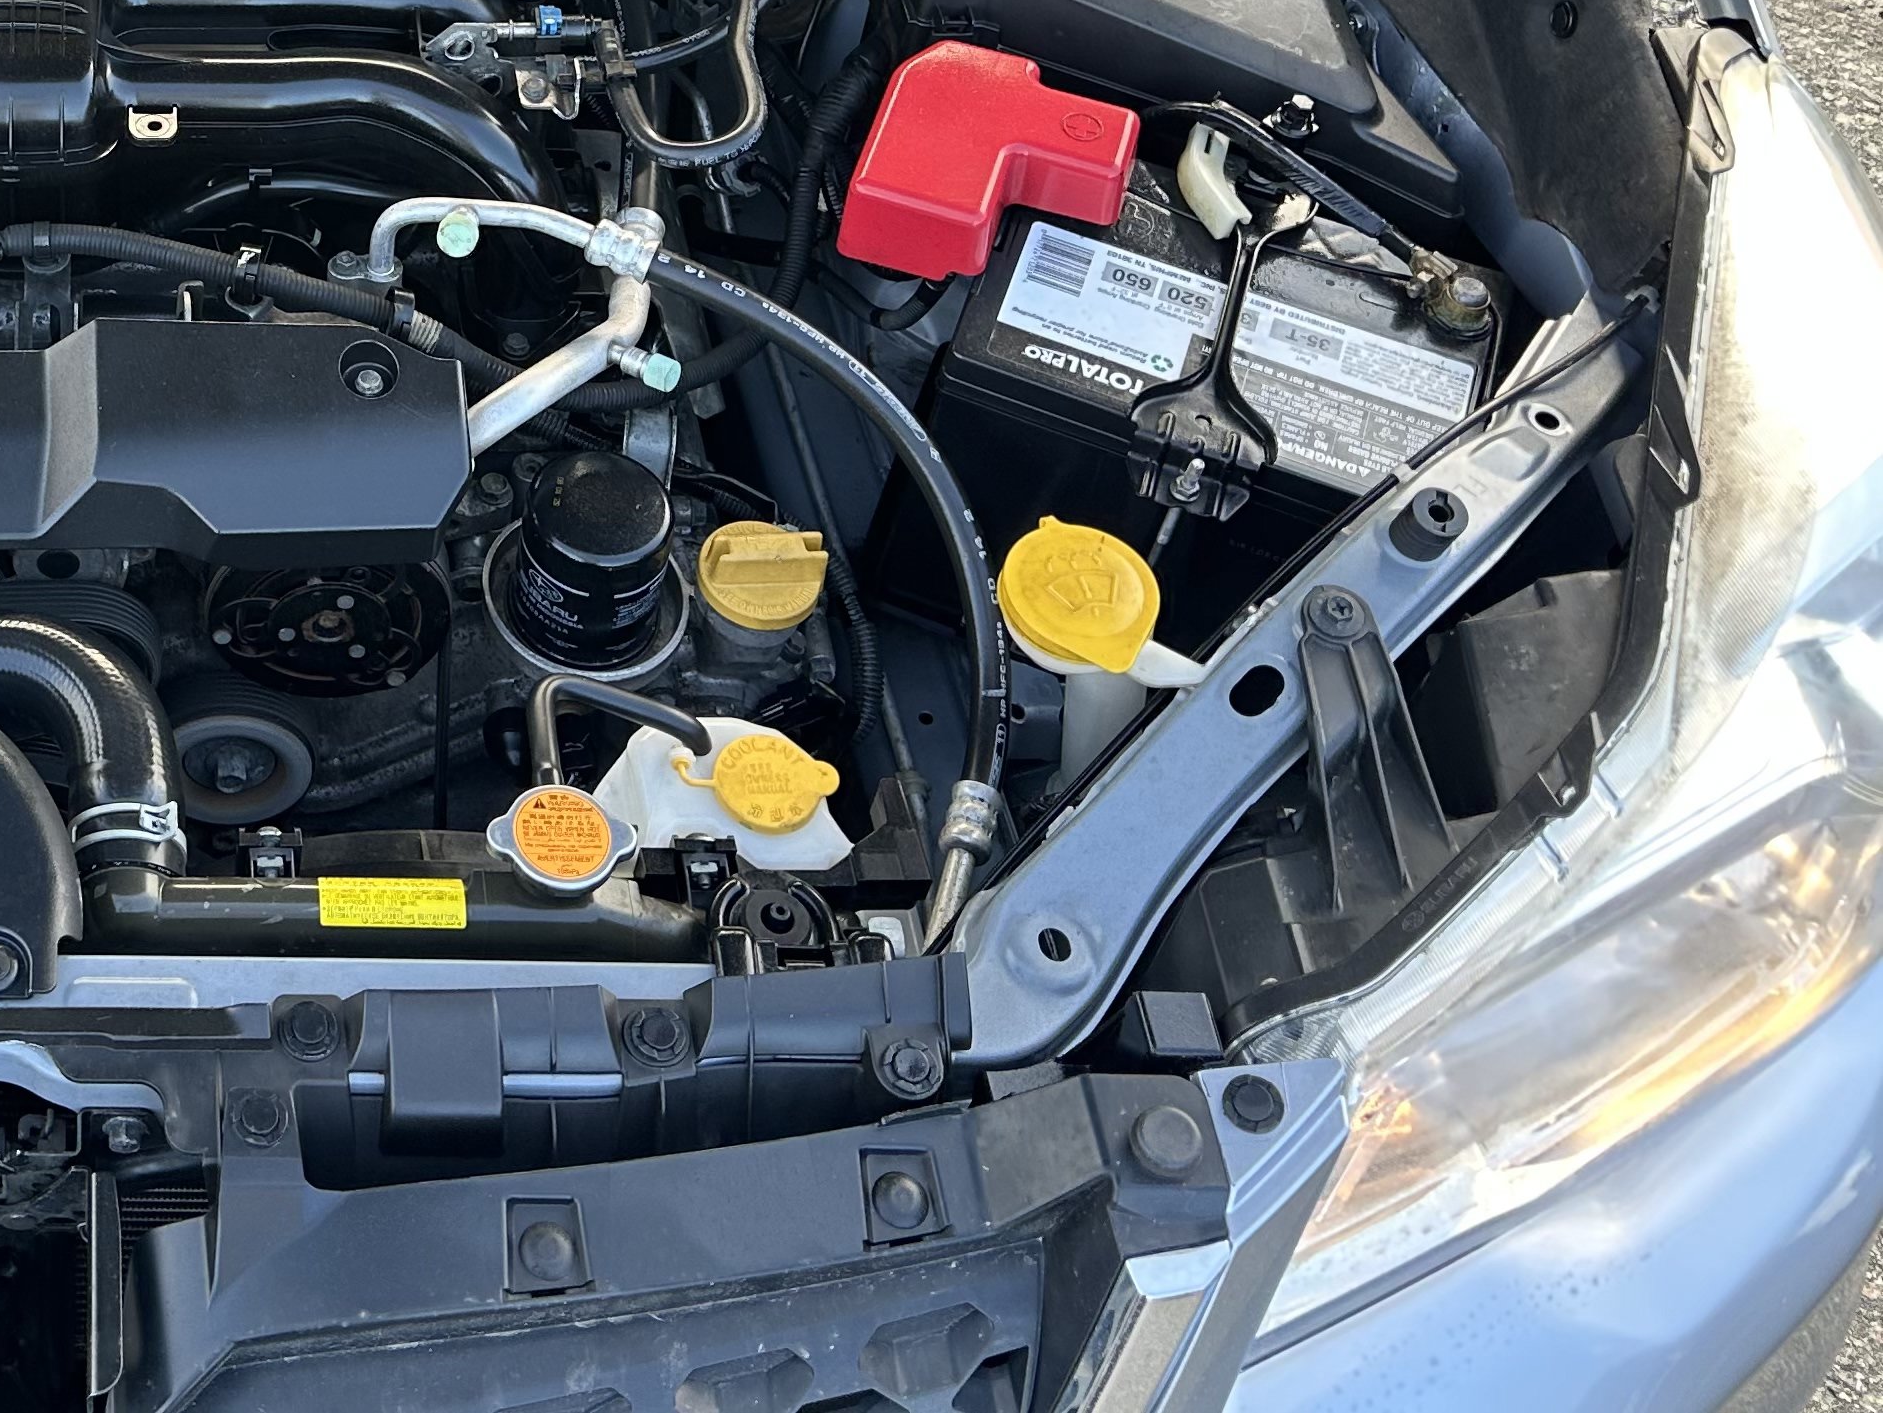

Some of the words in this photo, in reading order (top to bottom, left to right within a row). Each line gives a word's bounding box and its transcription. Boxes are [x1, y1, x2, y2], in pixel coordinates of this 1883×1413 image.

[684, 264, 706, 280] 14
[1111, 267, 1152, 291] 650
[721, 281, 747, 298] CD
[1166, 285, 1208, 310] 520
[1249, 297, 1271, 310] BEST
[1272, 306, 1286, 315] BY
[1287, 310, 1345, 335] DISTRIBUTED
[1284, 326, 1330, 352] 35-T
[1022, 342, 1144, 396] TOTALPRO
[1274, 436, 1358, 474] DANGER/P
[721, 737, 806, 769] COOLANT
